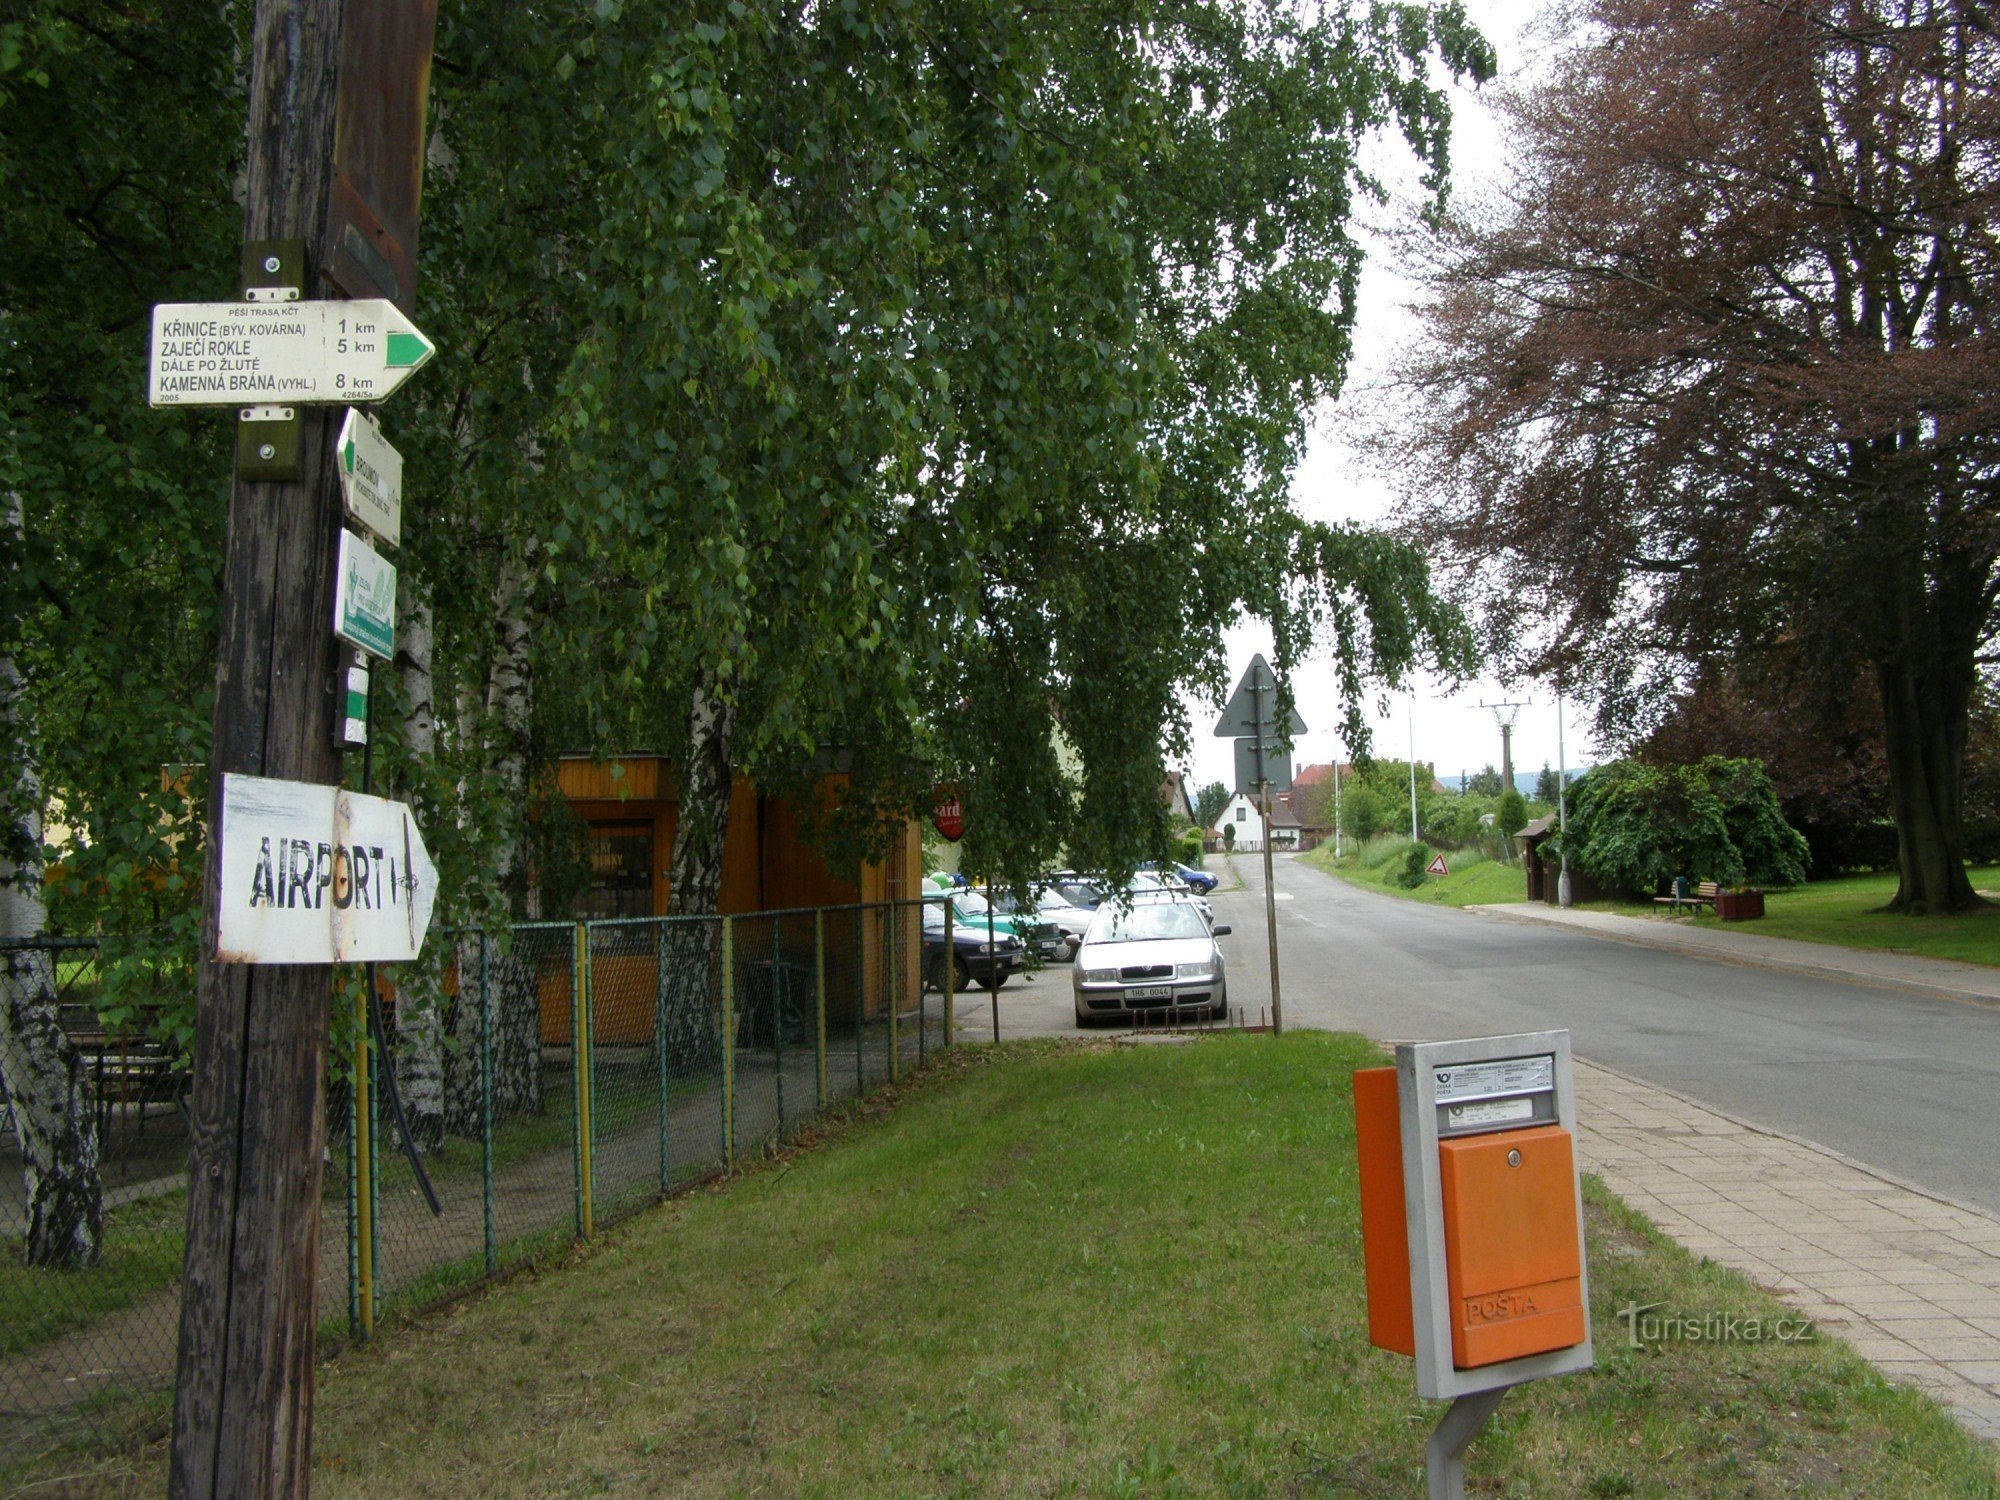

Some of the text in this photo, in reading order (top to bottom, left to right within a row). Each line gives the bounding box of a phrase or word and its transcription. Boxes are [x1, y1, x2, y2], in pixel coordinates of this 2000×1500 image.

[229, 307, 299, 317] PĚŠÍ TRASA KČT
[163, 318, 306, 339] KŘINICE (BÝV. KOVÁRNA)
[338, 318, 376, 334] 1 km
[161, 338, 251, 357] ZAJEČÍ ROKLE
[337, 338, 375, 354] 5 km
[161, 355, 260, 372] DÁLE PO ŽLUTÉ
[160, 372, 317, 392] KAMENNÁ BRÁNA (VYHL.)
[335, 373, 373, 389] 8 km
[341, 391, 373, 399] 4264/5a
[249, 836, 384, 910] AIRPORT
[1466, 1292, 1537, 1325] POŠTA
